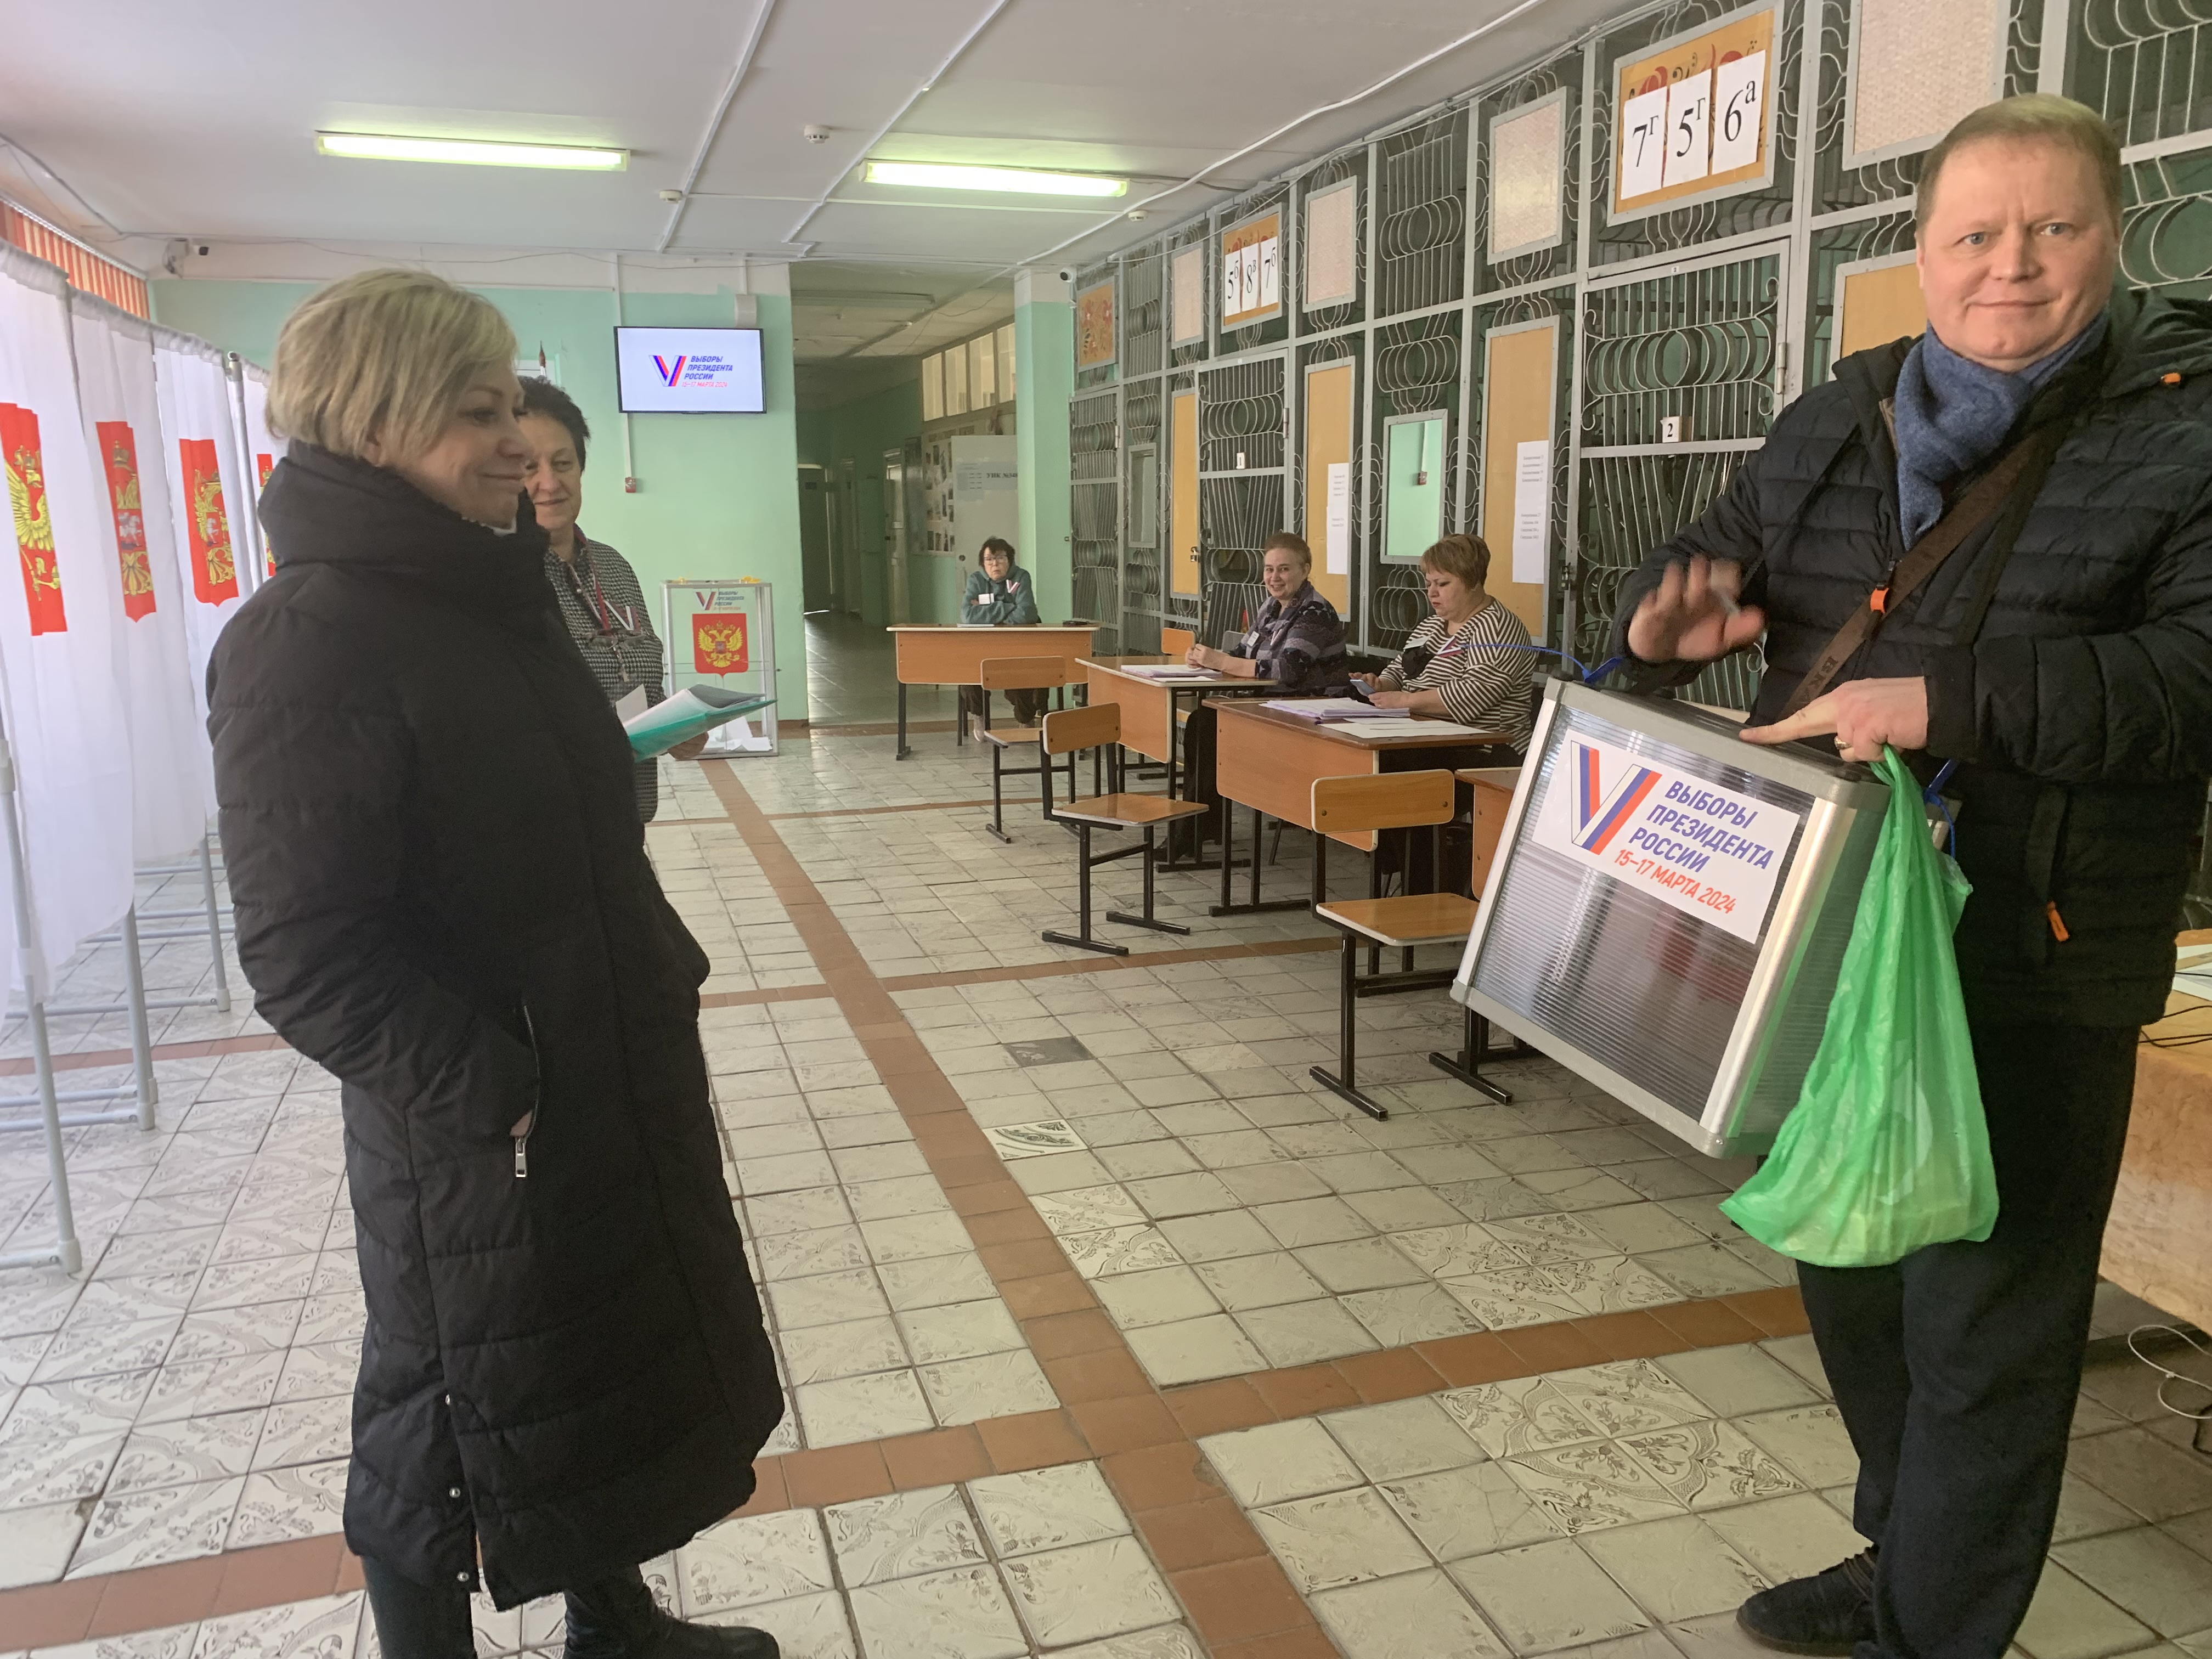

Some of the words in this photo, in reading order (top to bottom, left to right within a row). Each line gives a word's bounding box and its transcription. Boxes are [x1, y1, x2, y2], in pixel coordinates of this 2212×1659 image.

[1667, 422, 1673, 438] 2
[1664, 781, 1759, 829] ВЫБОРЫ
[1628, 827, 1711, 873] РОССИИ
[1646, 804, 1774, 870] ПРЕЗИДЕНТА
[1650, 865, 1701, 898] МАРТА
[1697, 887, 1736, 914] 2024
